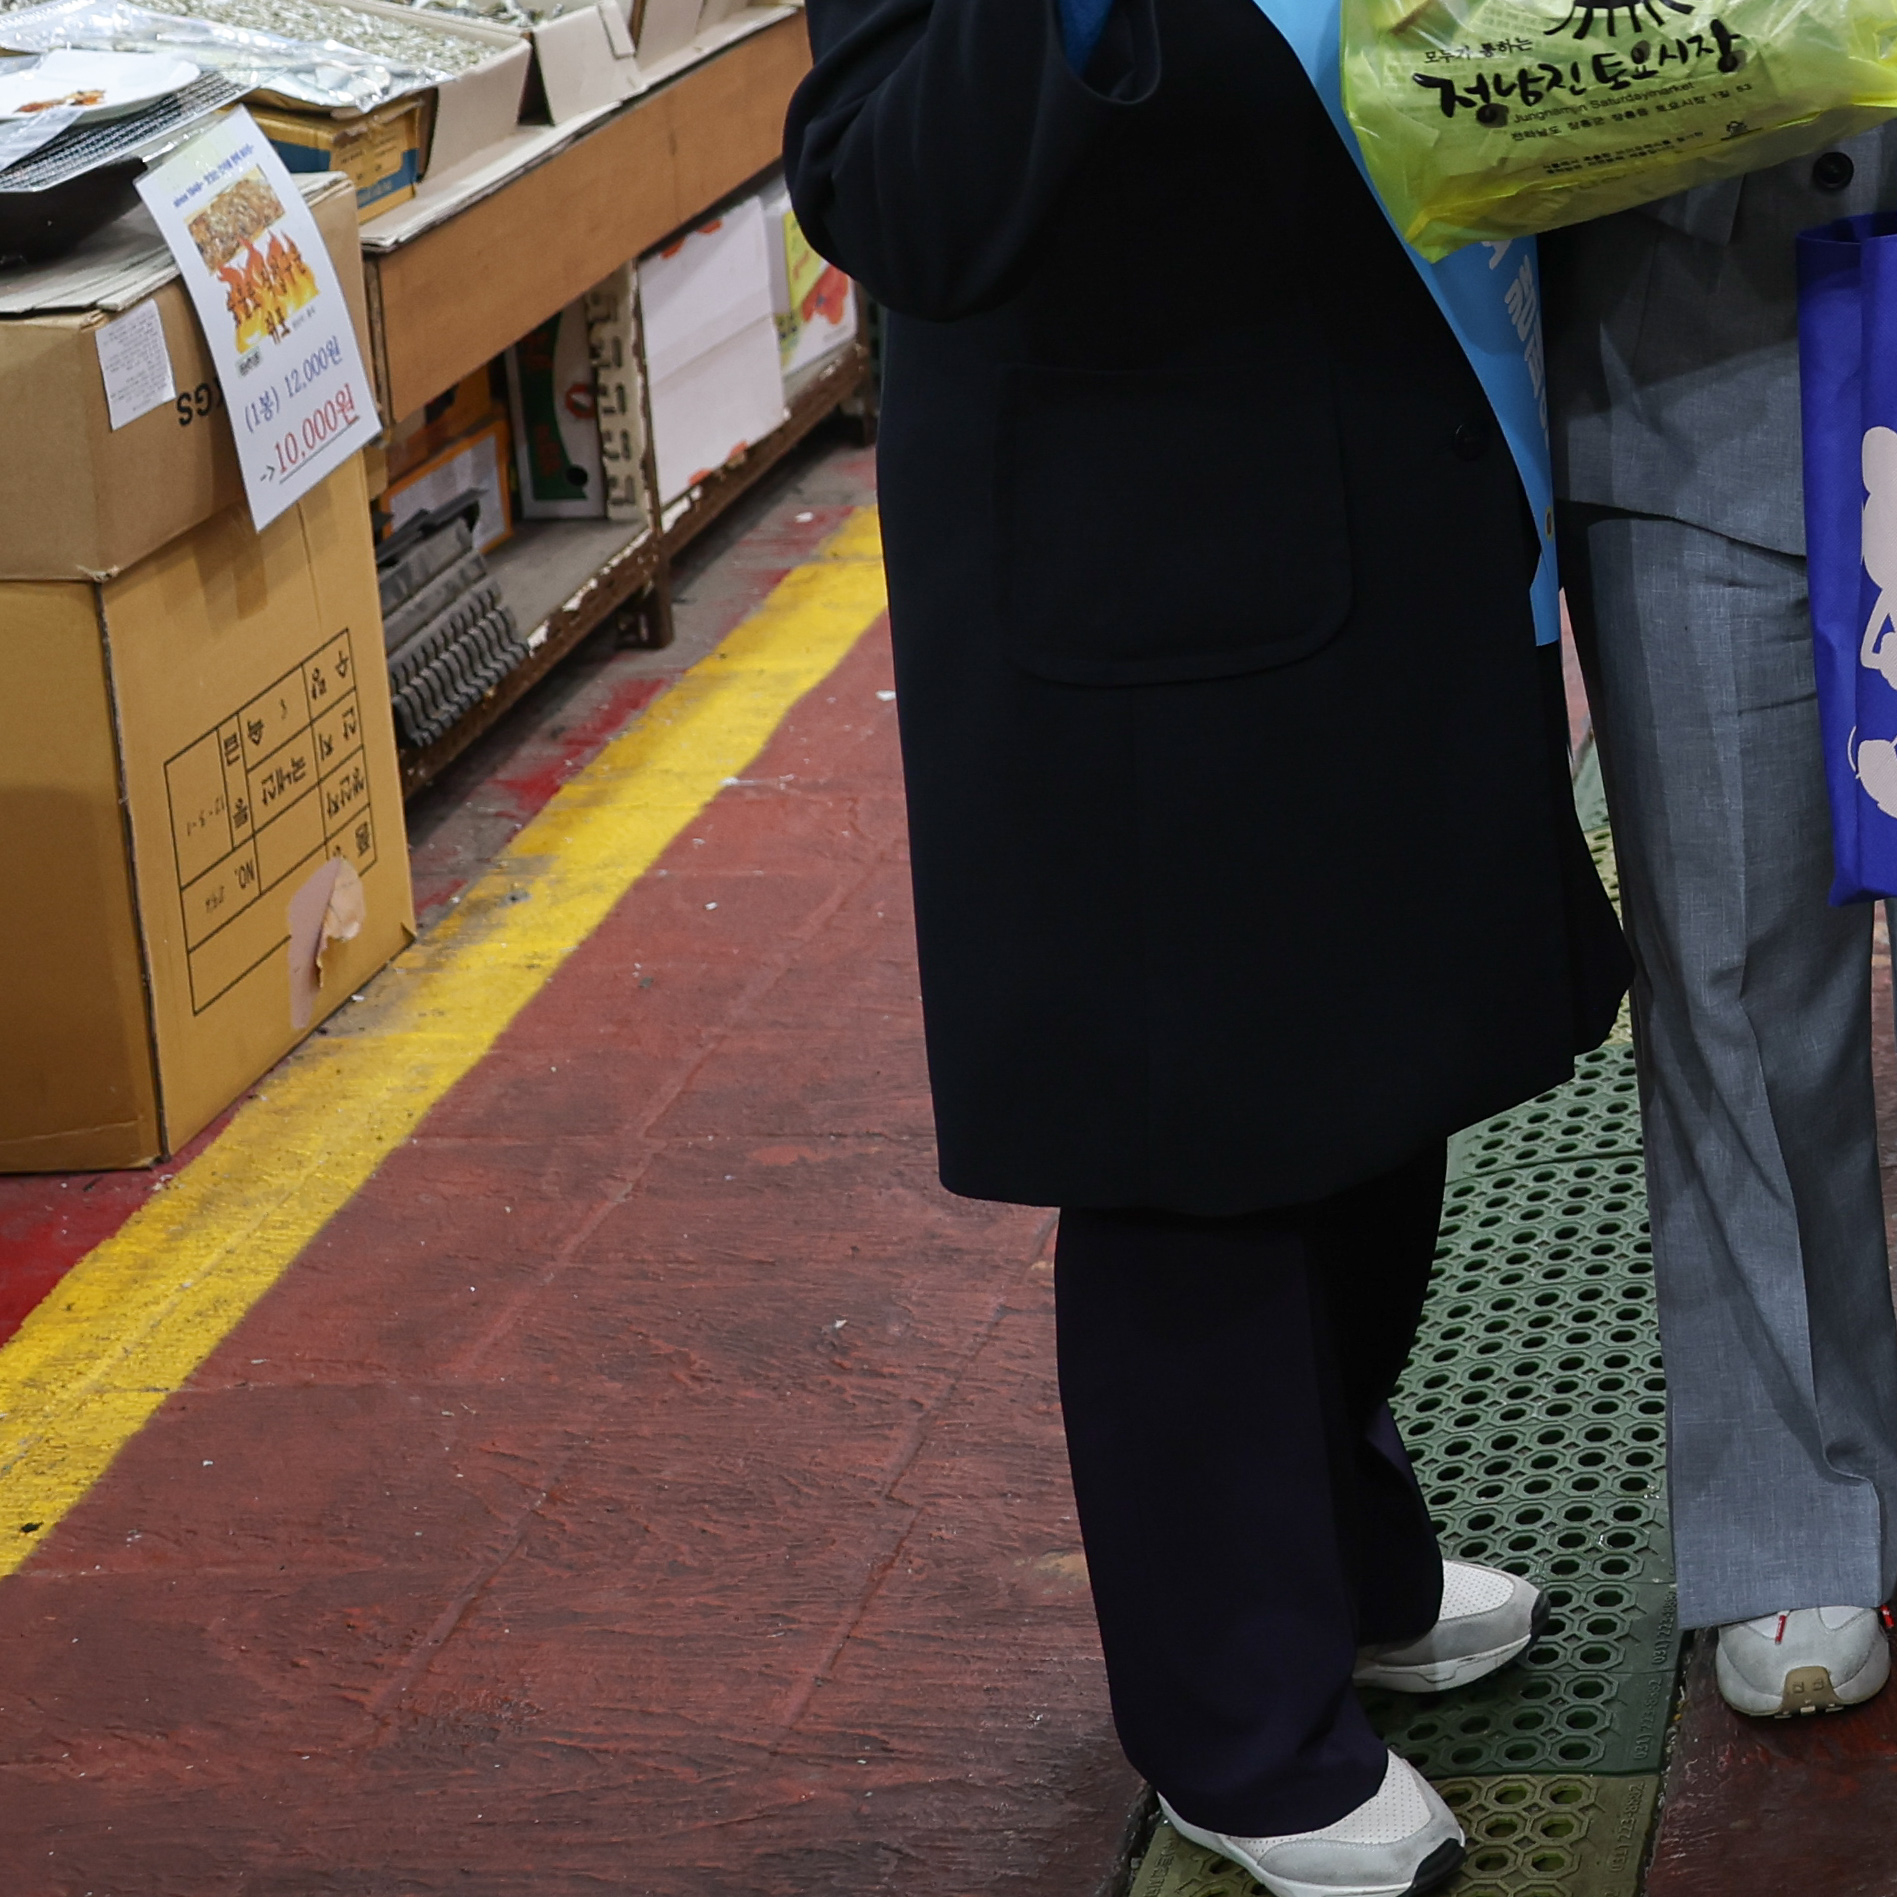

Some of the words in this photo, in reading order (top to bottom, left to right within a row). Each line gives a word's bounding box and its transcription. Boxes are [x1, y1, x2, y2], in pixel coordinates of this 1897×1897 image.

[1413, 60, 1588, 127] 정남진
[1592, 19, 1743, 91] 토요시장
[1424, 45, 1472, 64] 모두가
[1480, 37, 1533, 60] 통하는
[1512, 100, 1587, 125] Jungnamjin
[1590, 80, 1696, 110] Saturdaymarket
[176, 382, 222, 428] GS
[244, 384, 281, 436] (1봉)
[274, 383, 356, 474] 10,000원
[259, 748, 307, 807] 국내산
[233, 857, 254, 892] NO.
